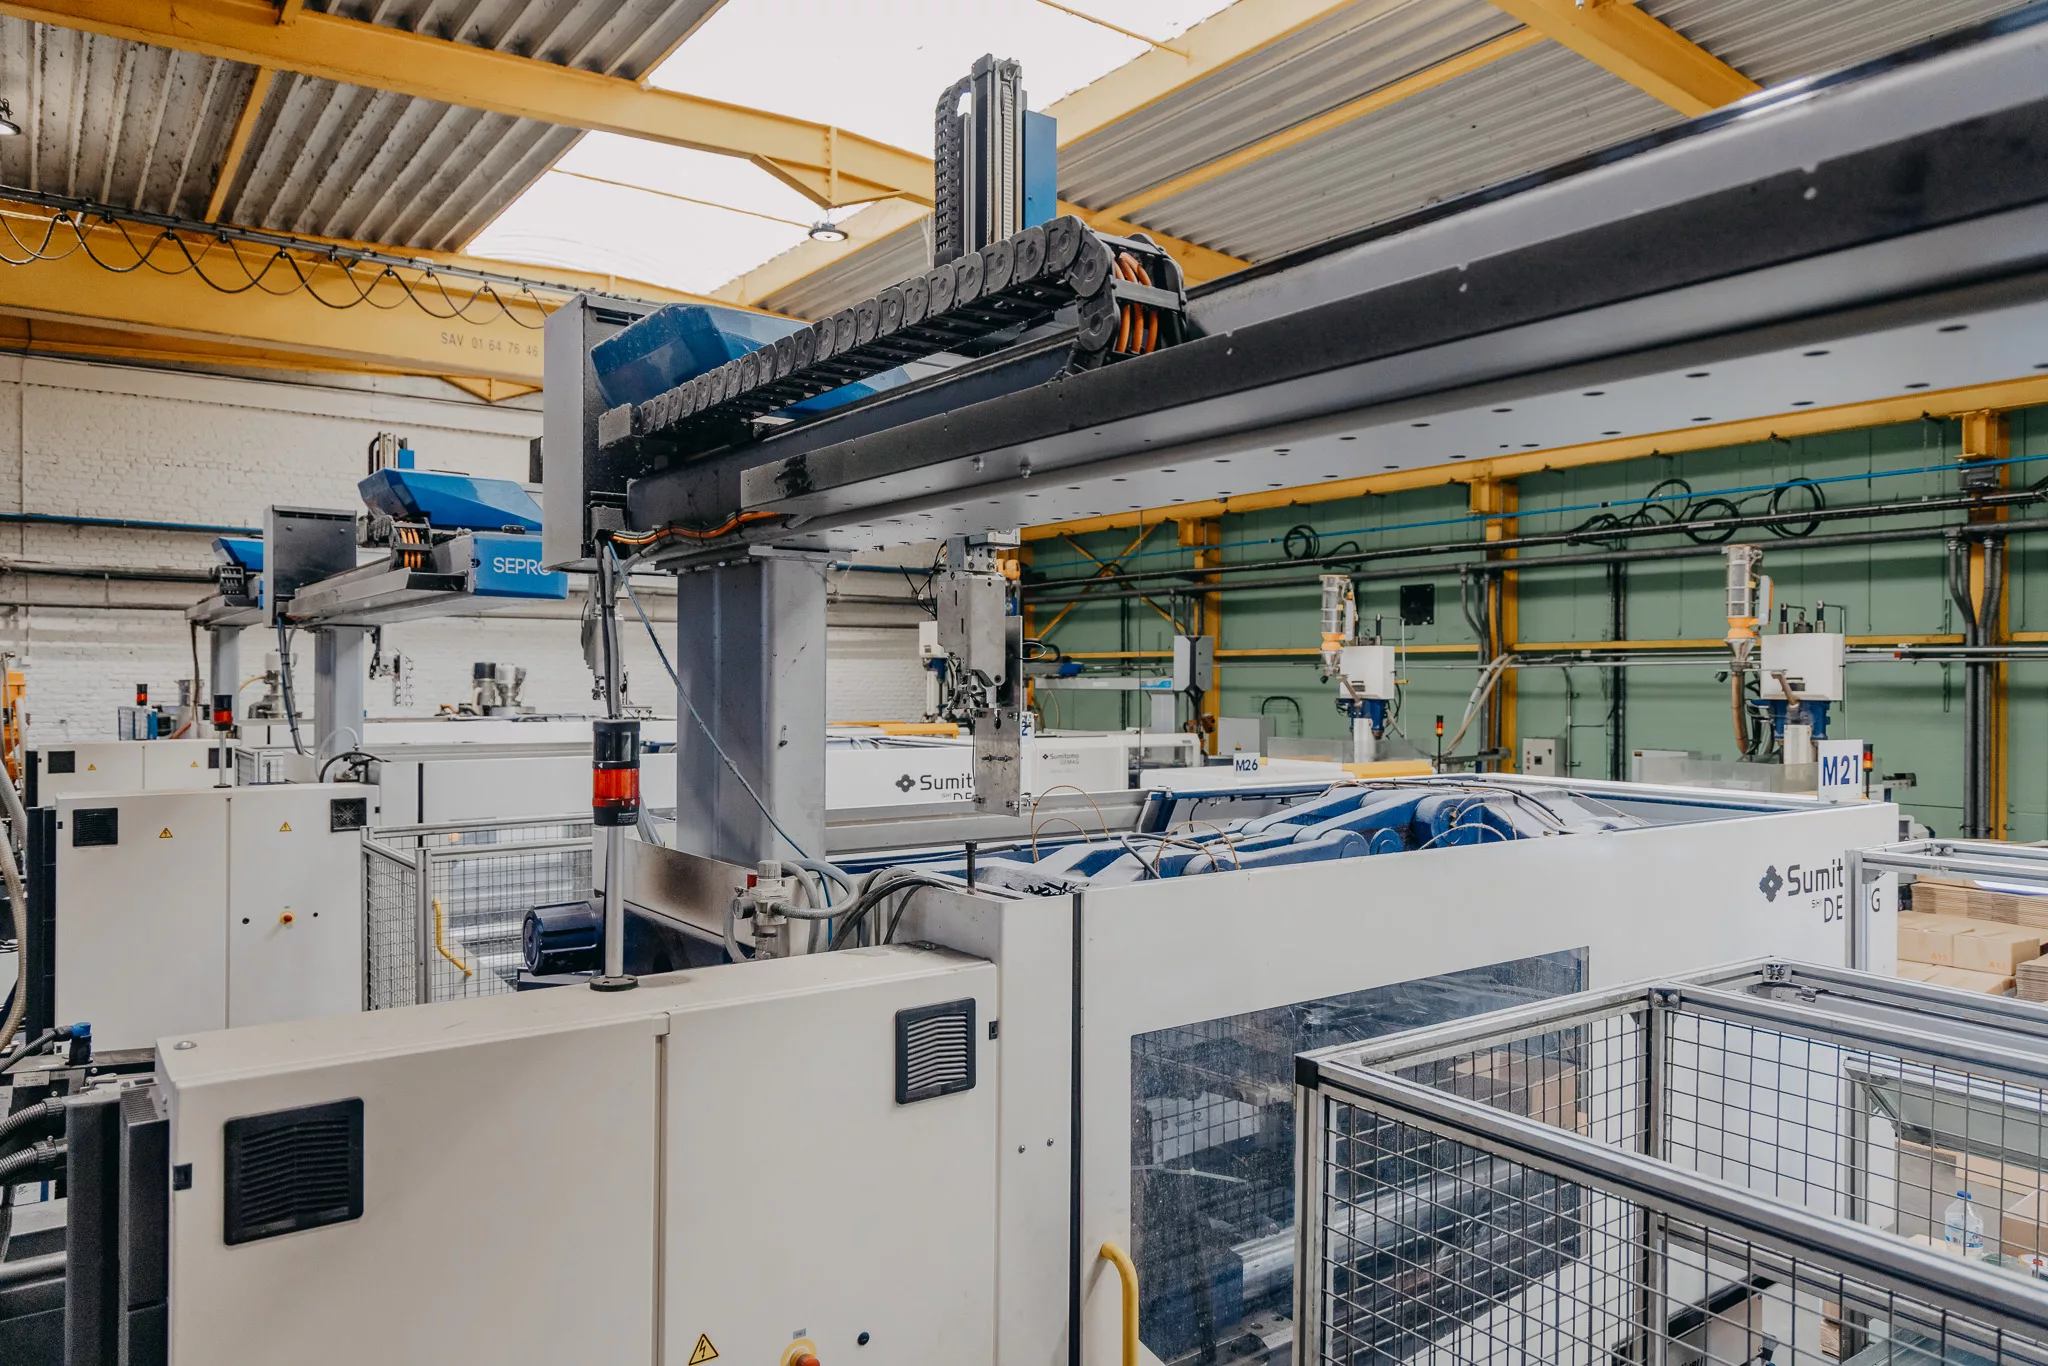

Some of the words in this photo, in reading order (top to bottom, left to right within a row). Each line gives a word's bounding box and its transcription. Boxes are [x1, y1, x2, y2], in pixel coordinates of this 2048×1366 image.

[441, 332, 464, 346] SAV
[471, 336, 483, 349] 01
[488, 340, 501, 351] 64
[1235, 758, 1259, 771] M26
[1823, 754, 1859, 786] M21
[920, 773, 973, 790] Sumit
[1787, 858, 1844, 896] Sumit
